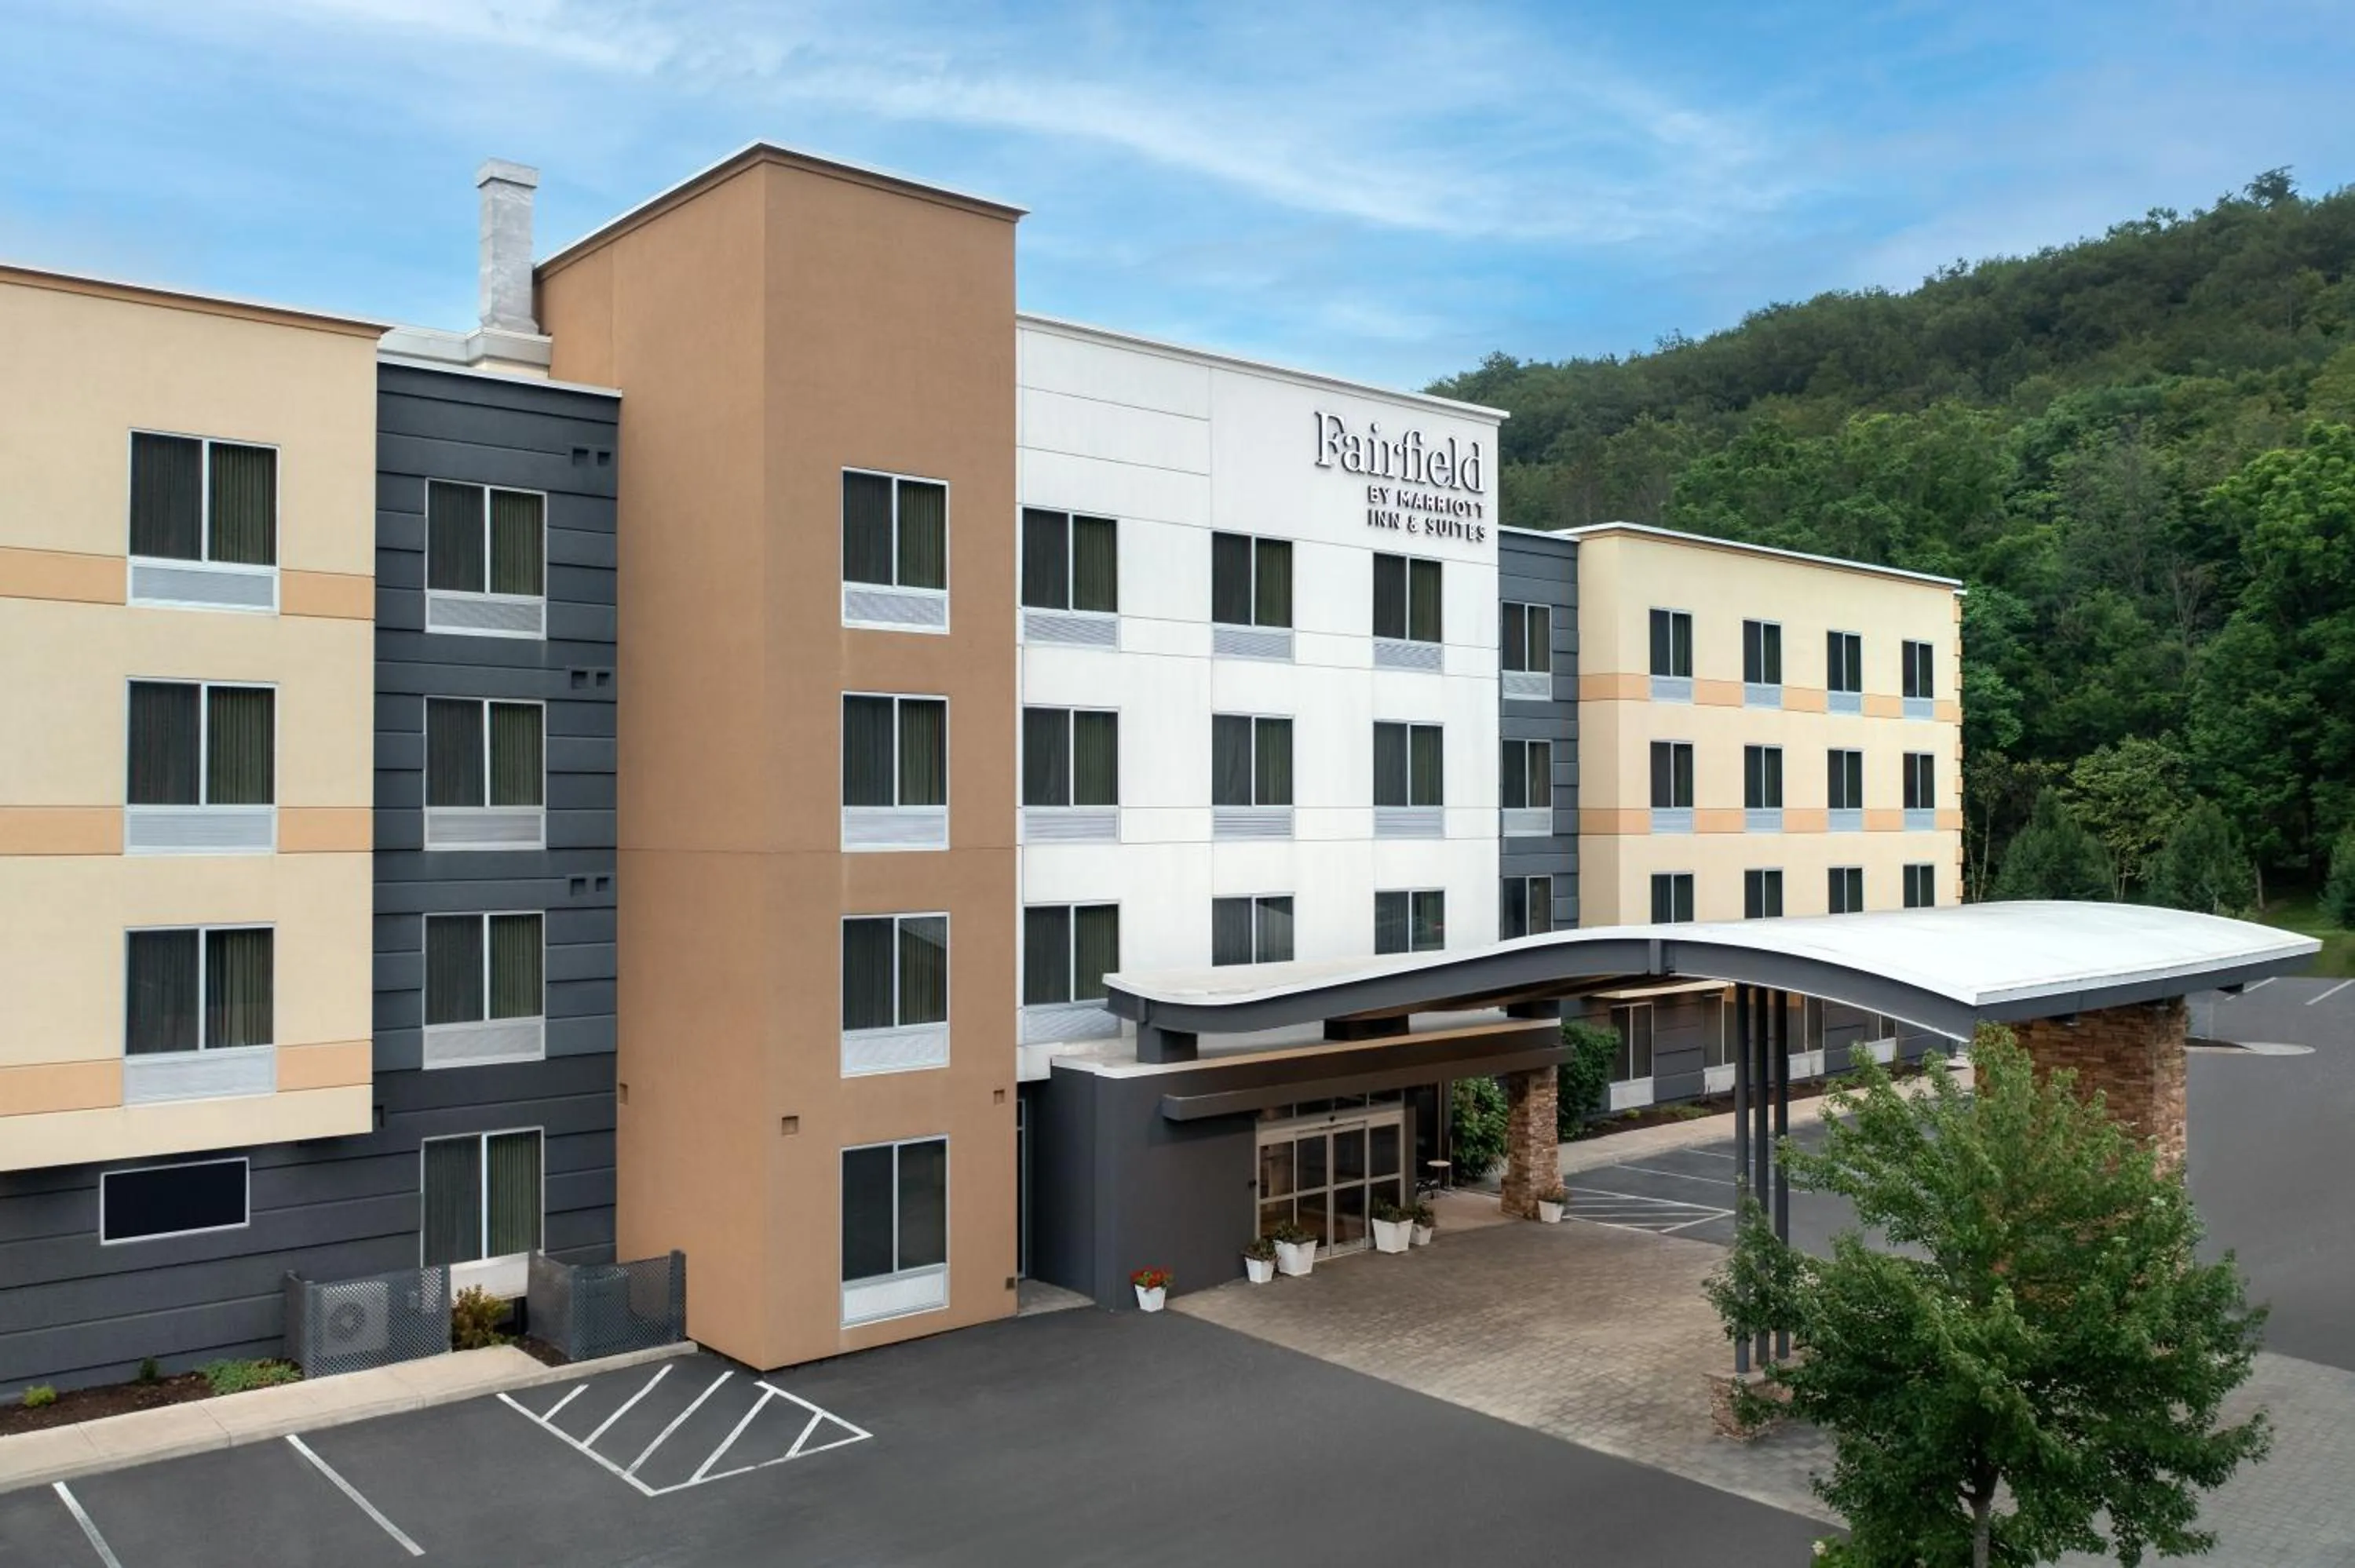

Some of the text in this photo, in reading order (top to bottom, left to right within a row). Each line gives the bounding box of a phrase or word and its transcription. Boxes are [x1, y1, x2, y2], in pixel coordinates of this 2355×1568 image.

[1314, 410, 1484, 494] Fairfield
[1367, 485, 1484, 519] BY MARRIOTT
[1367, 508, 1485, 542] INN & SUITES
